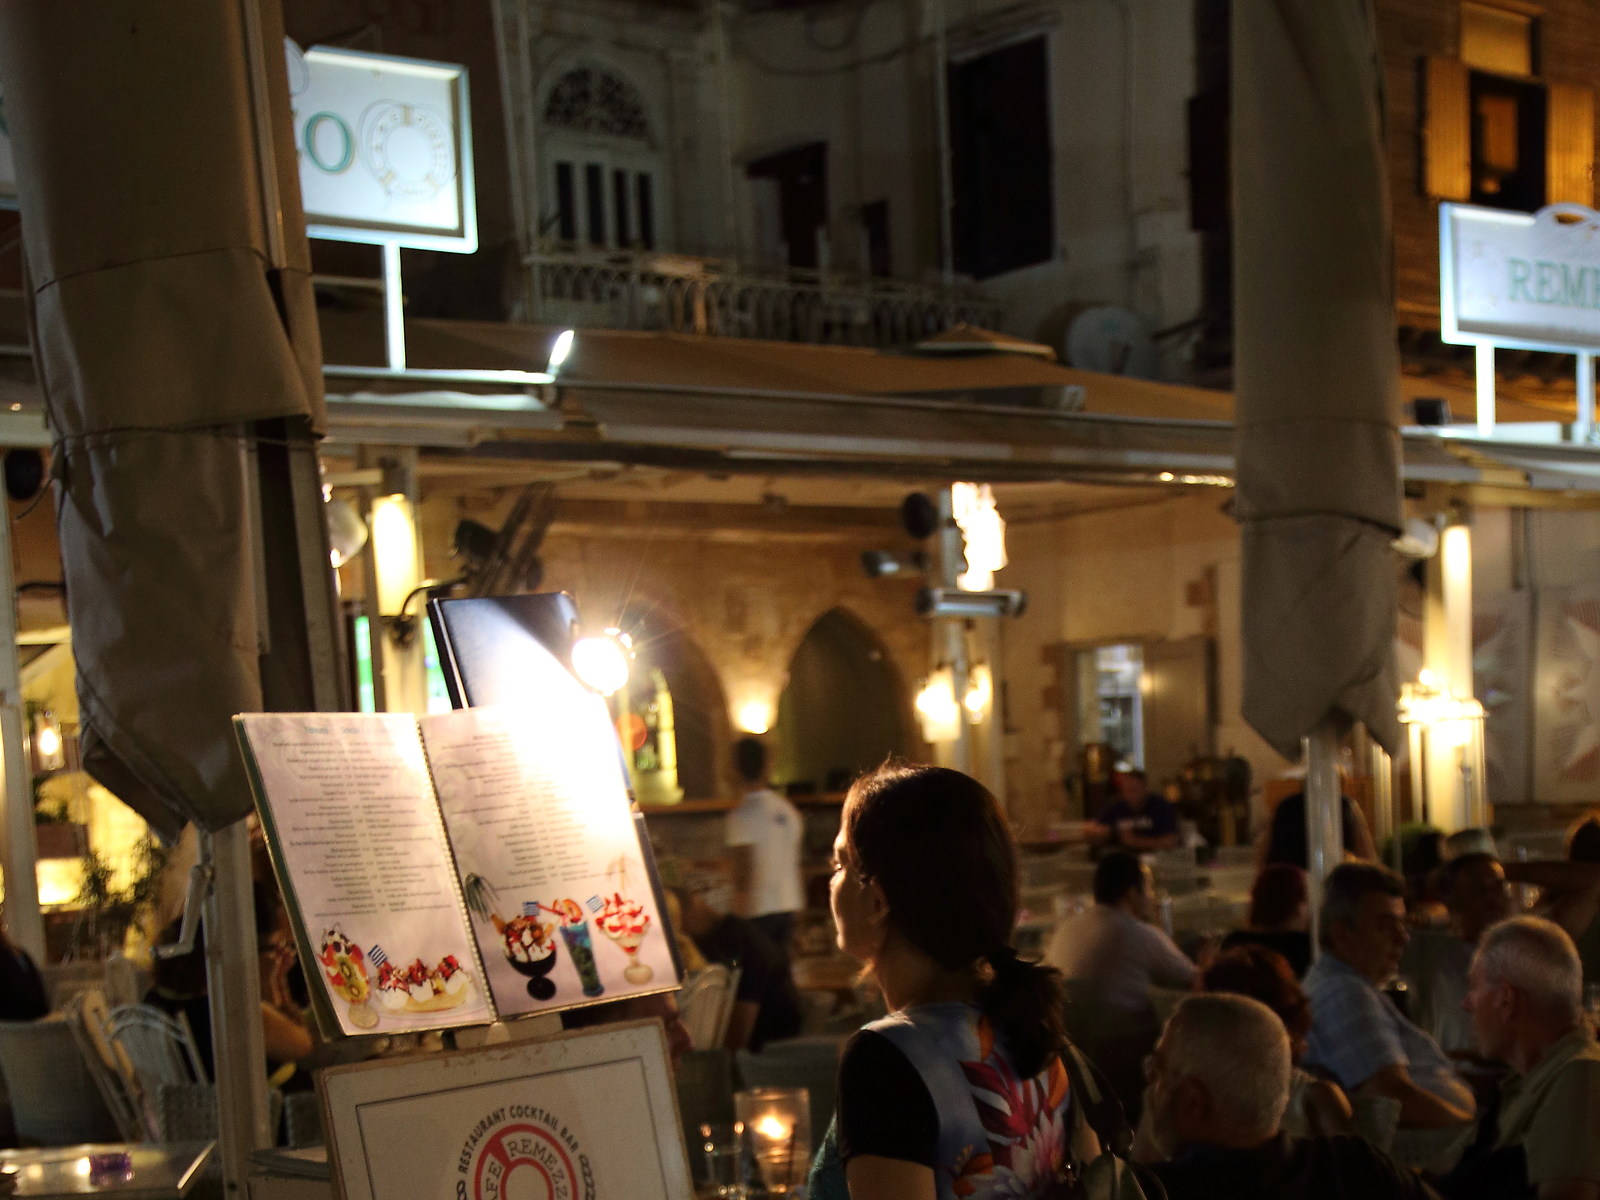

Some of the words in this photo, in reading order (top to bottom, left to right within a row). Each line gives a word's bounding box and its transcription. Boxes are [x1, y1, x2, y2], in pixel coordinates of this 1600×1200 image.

[457, 1107, 506, 1174] RESTAURANT
[510, 1105, 559, 1131] COCKTAIL
[560, 1126, 580, 1152] BAR
